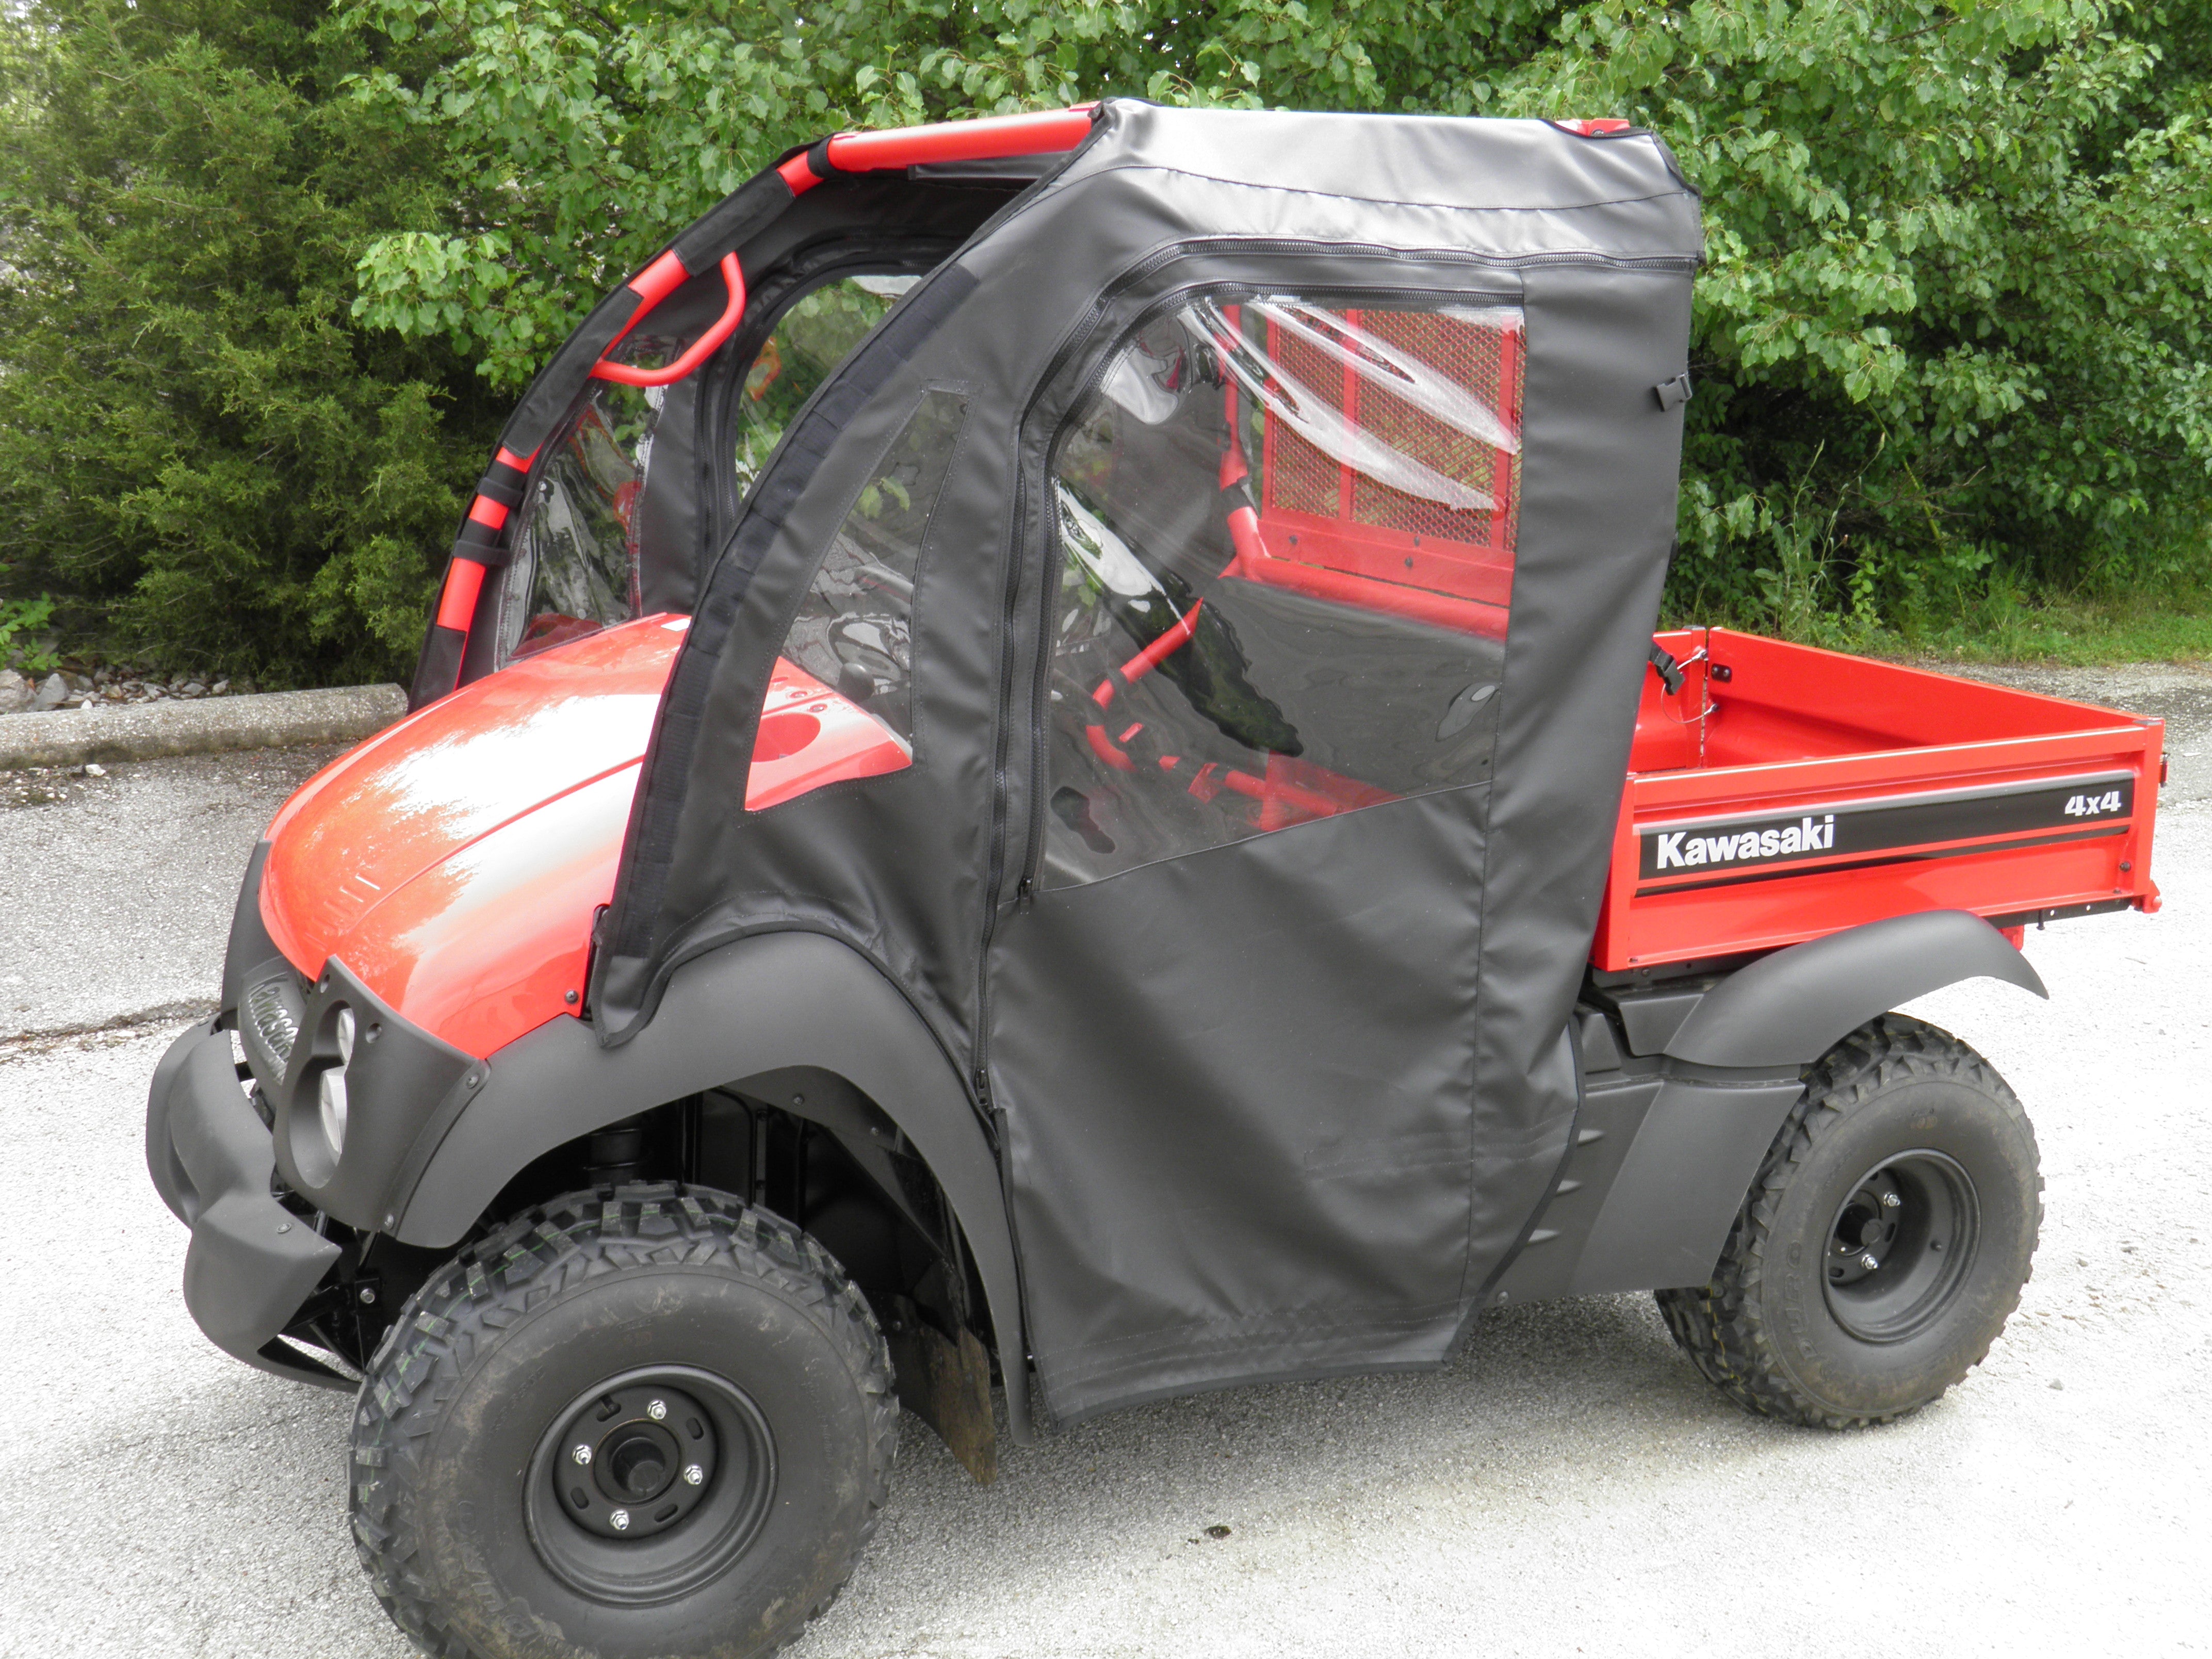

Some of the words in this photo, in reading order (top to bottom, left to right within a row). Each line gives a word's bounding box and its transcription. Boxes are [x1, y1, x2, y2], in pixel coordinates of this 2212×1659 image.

[2064, 790, 2122, 817] 4x4
[1657, 815, 1834, 869] Kawasaki
[248, 971, 299, 1064] Kawasak
